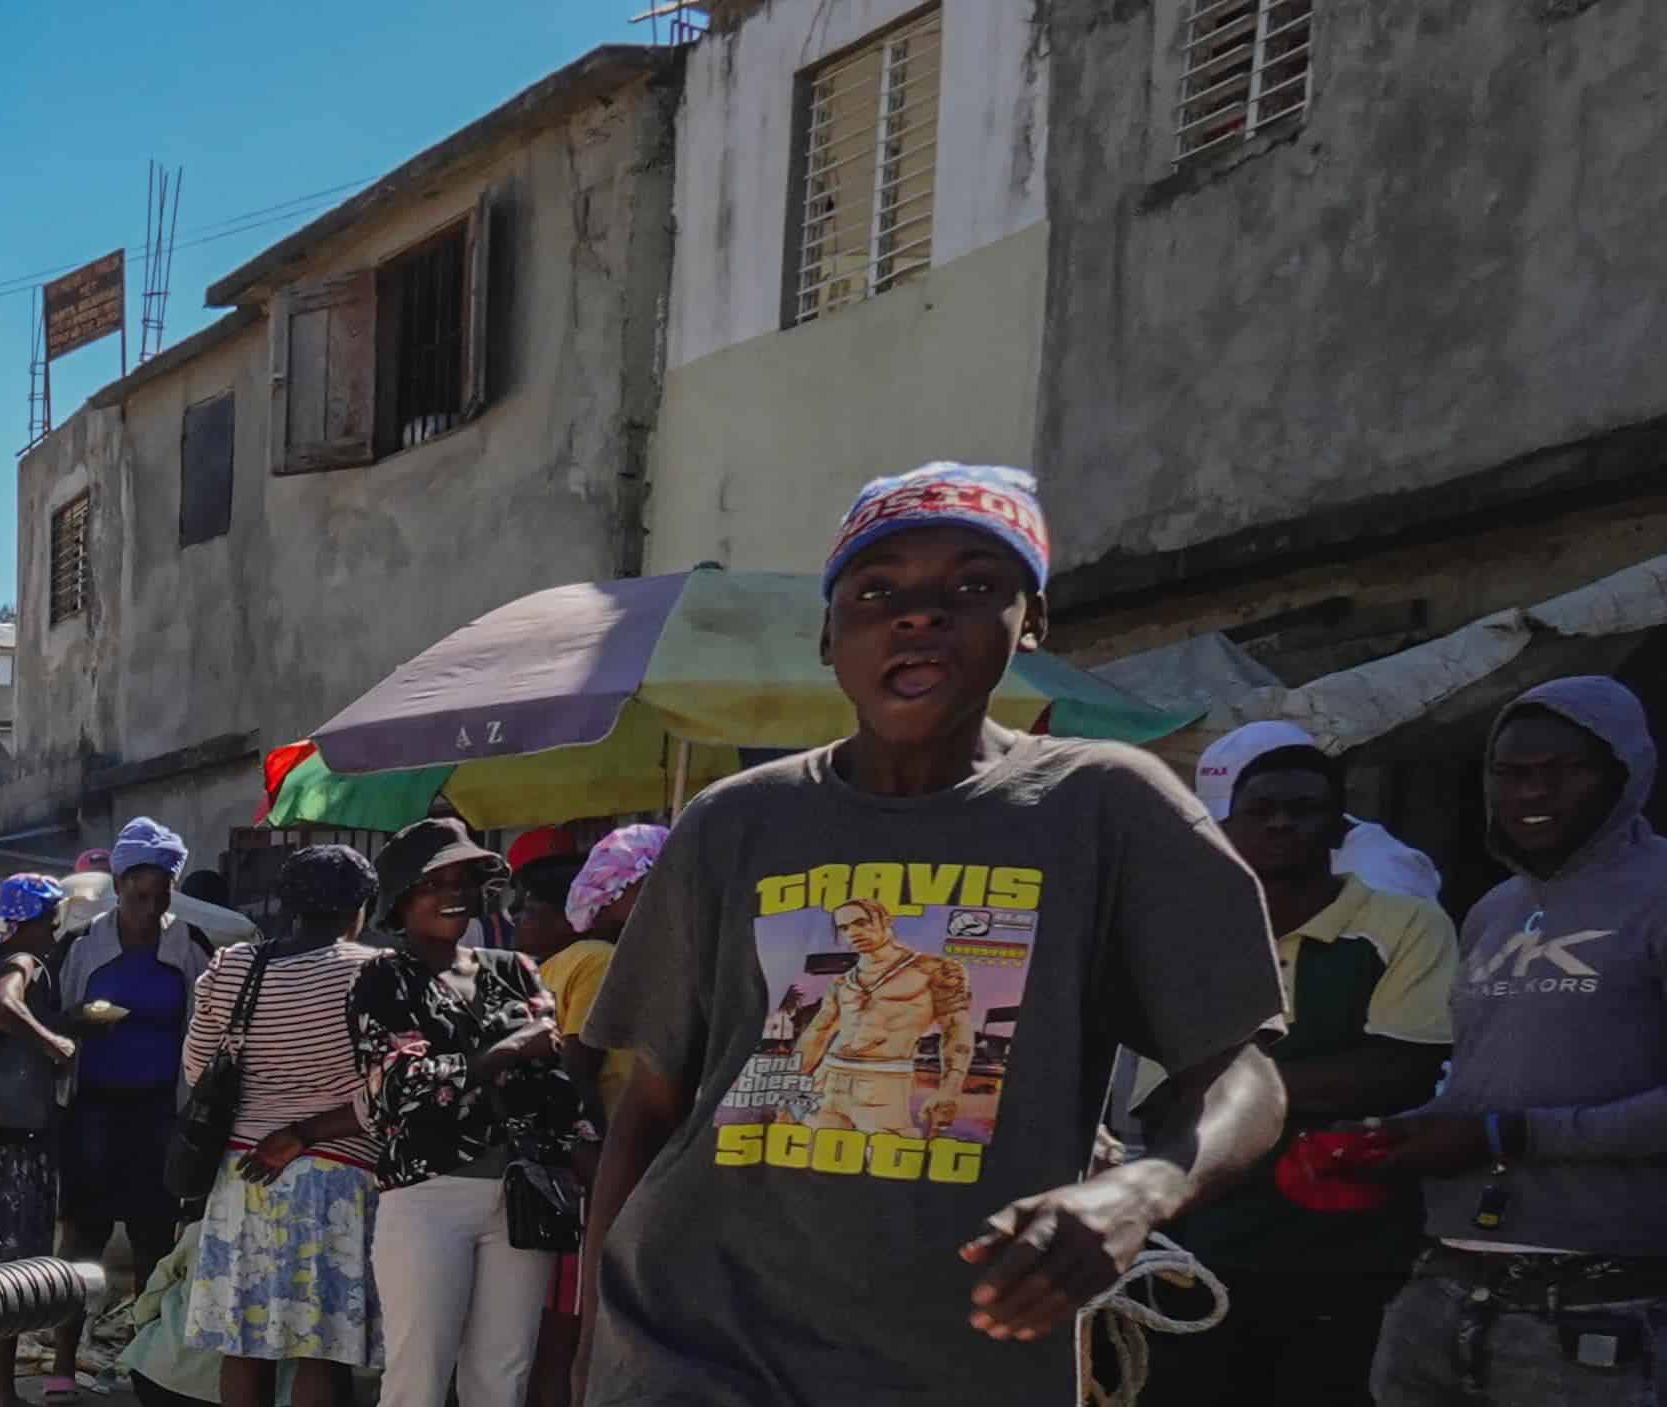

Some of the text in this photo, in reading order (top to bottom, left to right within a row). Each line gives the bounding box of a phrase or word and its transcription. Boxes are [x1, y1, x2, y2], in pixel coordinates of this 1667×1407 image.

[486, 721, 504, 745] Z
[755, 862, 1043, 917] TRAVIS
[1524, 978, 1599, 994] KORS
[714, 1122, 985, 1184] SCOTT
